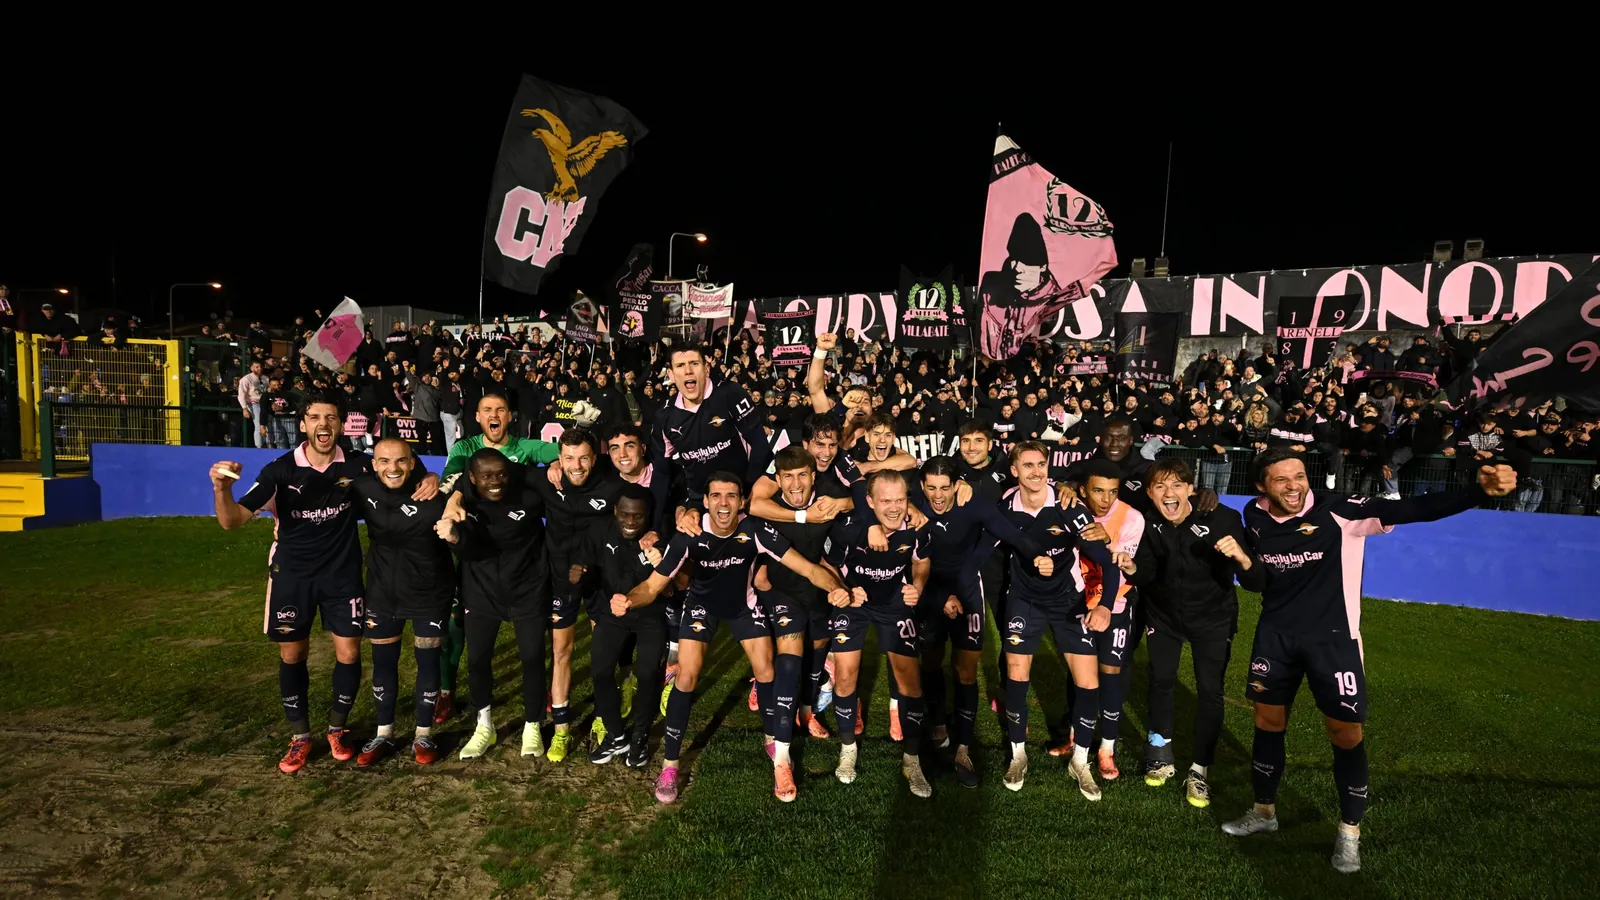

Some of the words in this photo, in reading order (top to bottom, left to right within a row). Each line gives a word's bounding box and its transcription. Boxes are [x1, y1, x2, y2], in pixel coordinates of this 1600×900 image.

[1054, 193, 1095, 223] 12
[619, 290, 652, 300] GIRANDO
[918, 287, 939, 309] 12
[620, 303, 649, 312] STIVALE
[1191, 275, 1266, 336] IN
[1290, 311, 1297, 325] 1
[1333, 309, 1345, 324] 9
[780, 325, 802, 345] 12
[901, 323, 950, 338] VILLABATE
[1280, 327, 1338, 338] ARENELL
[1281, 341, 1291, 355] 8
[1117, 371, 1173, 383] OSANERO
[730, 556, 746, 565] Car
[1263, 553, 1289, 565] Sicily
[1288, 552, 1305, 564] by
[1303, 551, 1324, 561] Car
[864, 567, 886, 578] Sicily
[349, 597, 364, 618] 13
[896, 618, 916, 639] 20
[967, 612, 981, 633] 10
[1112, 627, 1127, 648] 18
[1334, 671, 1358, 697] 19
